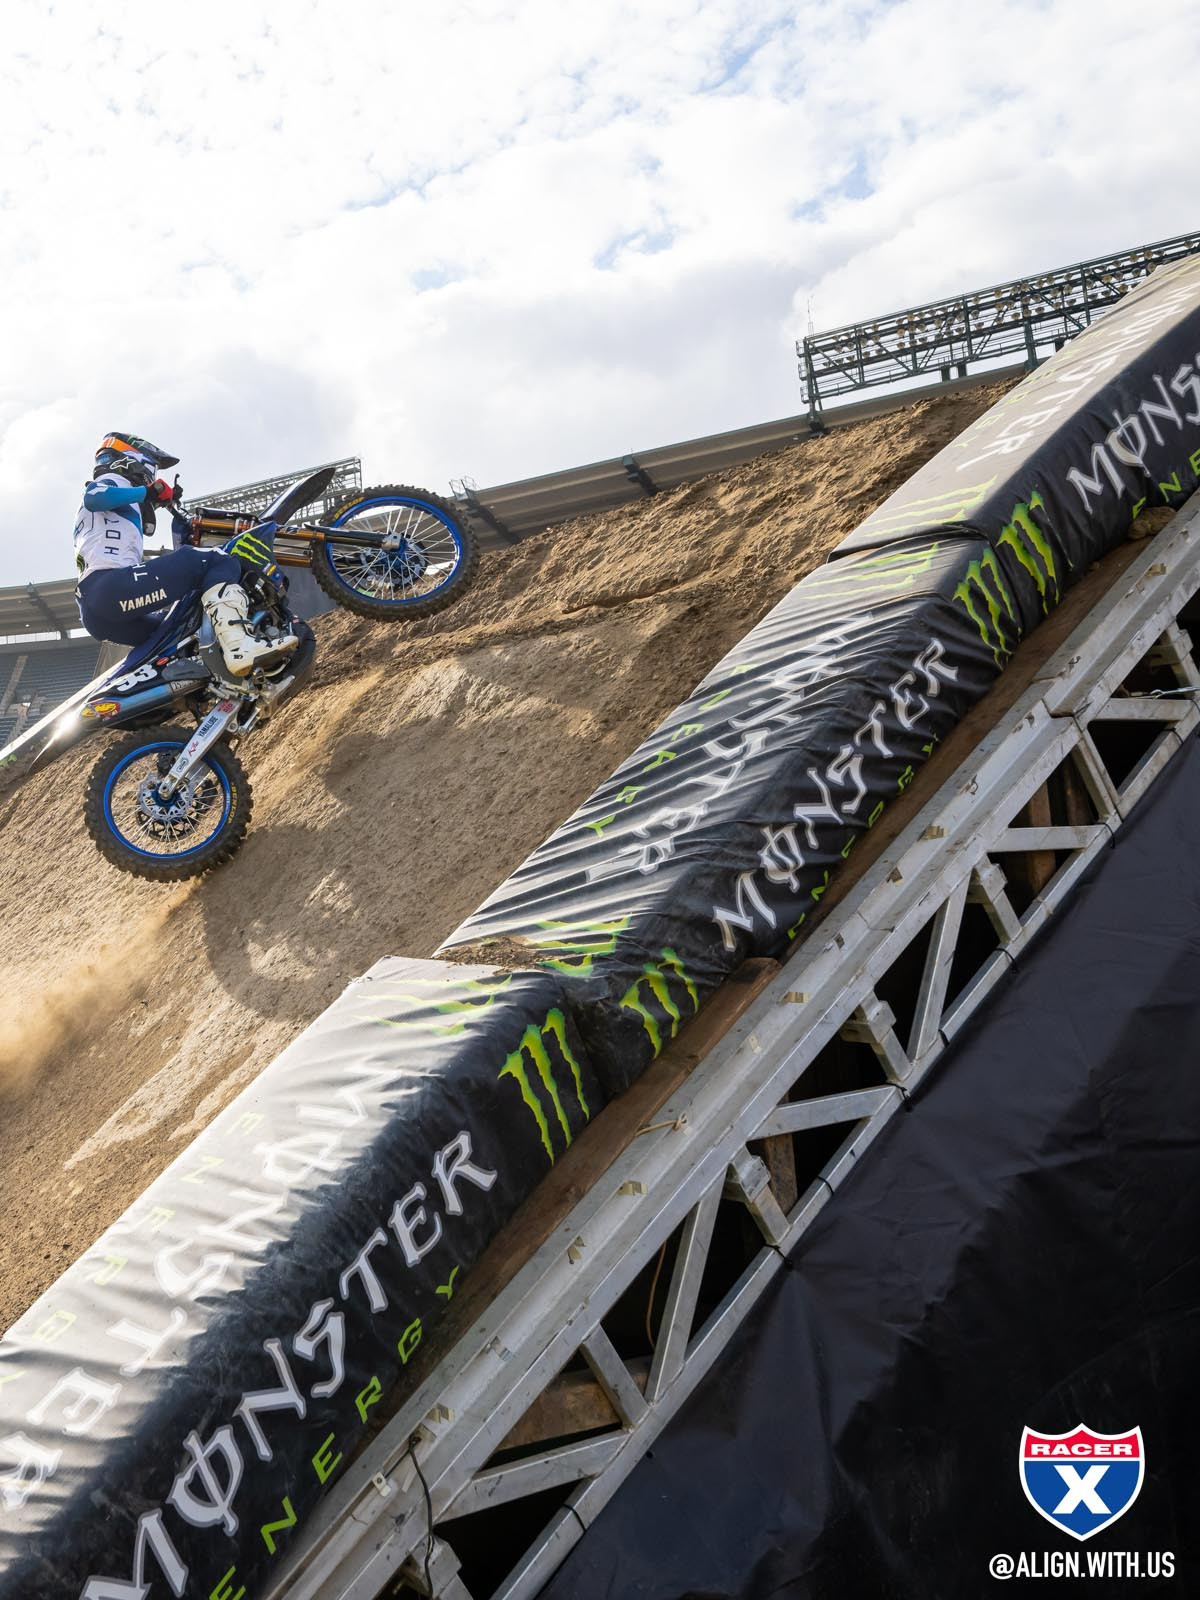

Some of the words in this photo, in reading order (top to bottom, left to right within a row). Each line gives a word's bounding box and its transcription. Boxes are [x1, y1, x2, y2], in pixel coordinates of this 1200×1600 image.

[1066, 352, 1200, 516] MONS
[119, 588, 167, 613] YAMAHA
[208, 1265, 460, 1600] ENERGY
